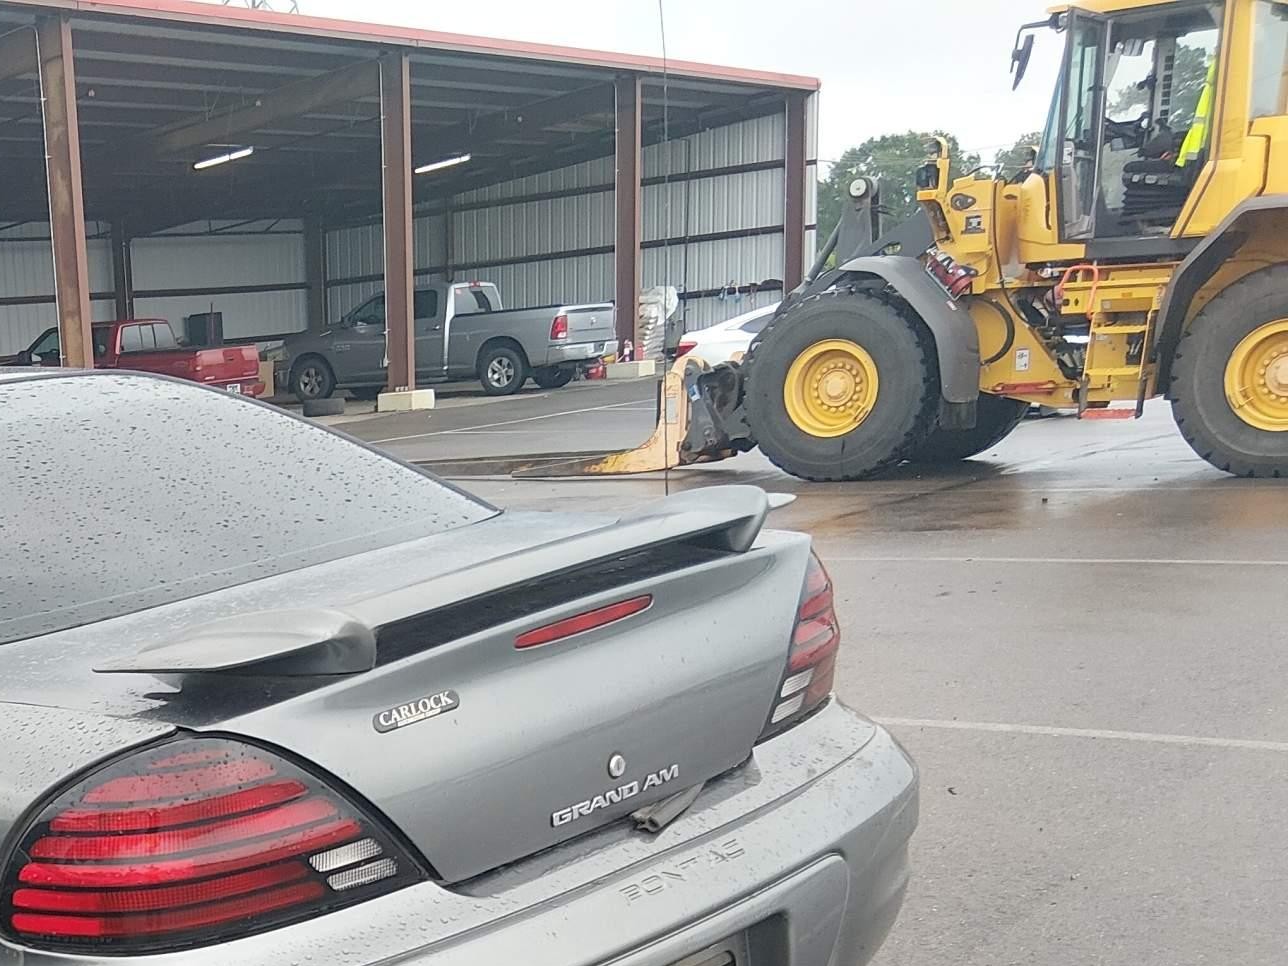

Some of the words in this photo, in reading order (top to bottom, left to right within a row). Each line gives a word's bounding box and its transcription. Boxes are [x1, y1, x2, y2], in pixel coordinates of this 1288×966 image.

[379, 690, 454, 726] CARLOCK
[551, 781, 640, 827] GRAND
[642, 764, 680, 792] AM
[617, 838, 746, 907] PONTAC
